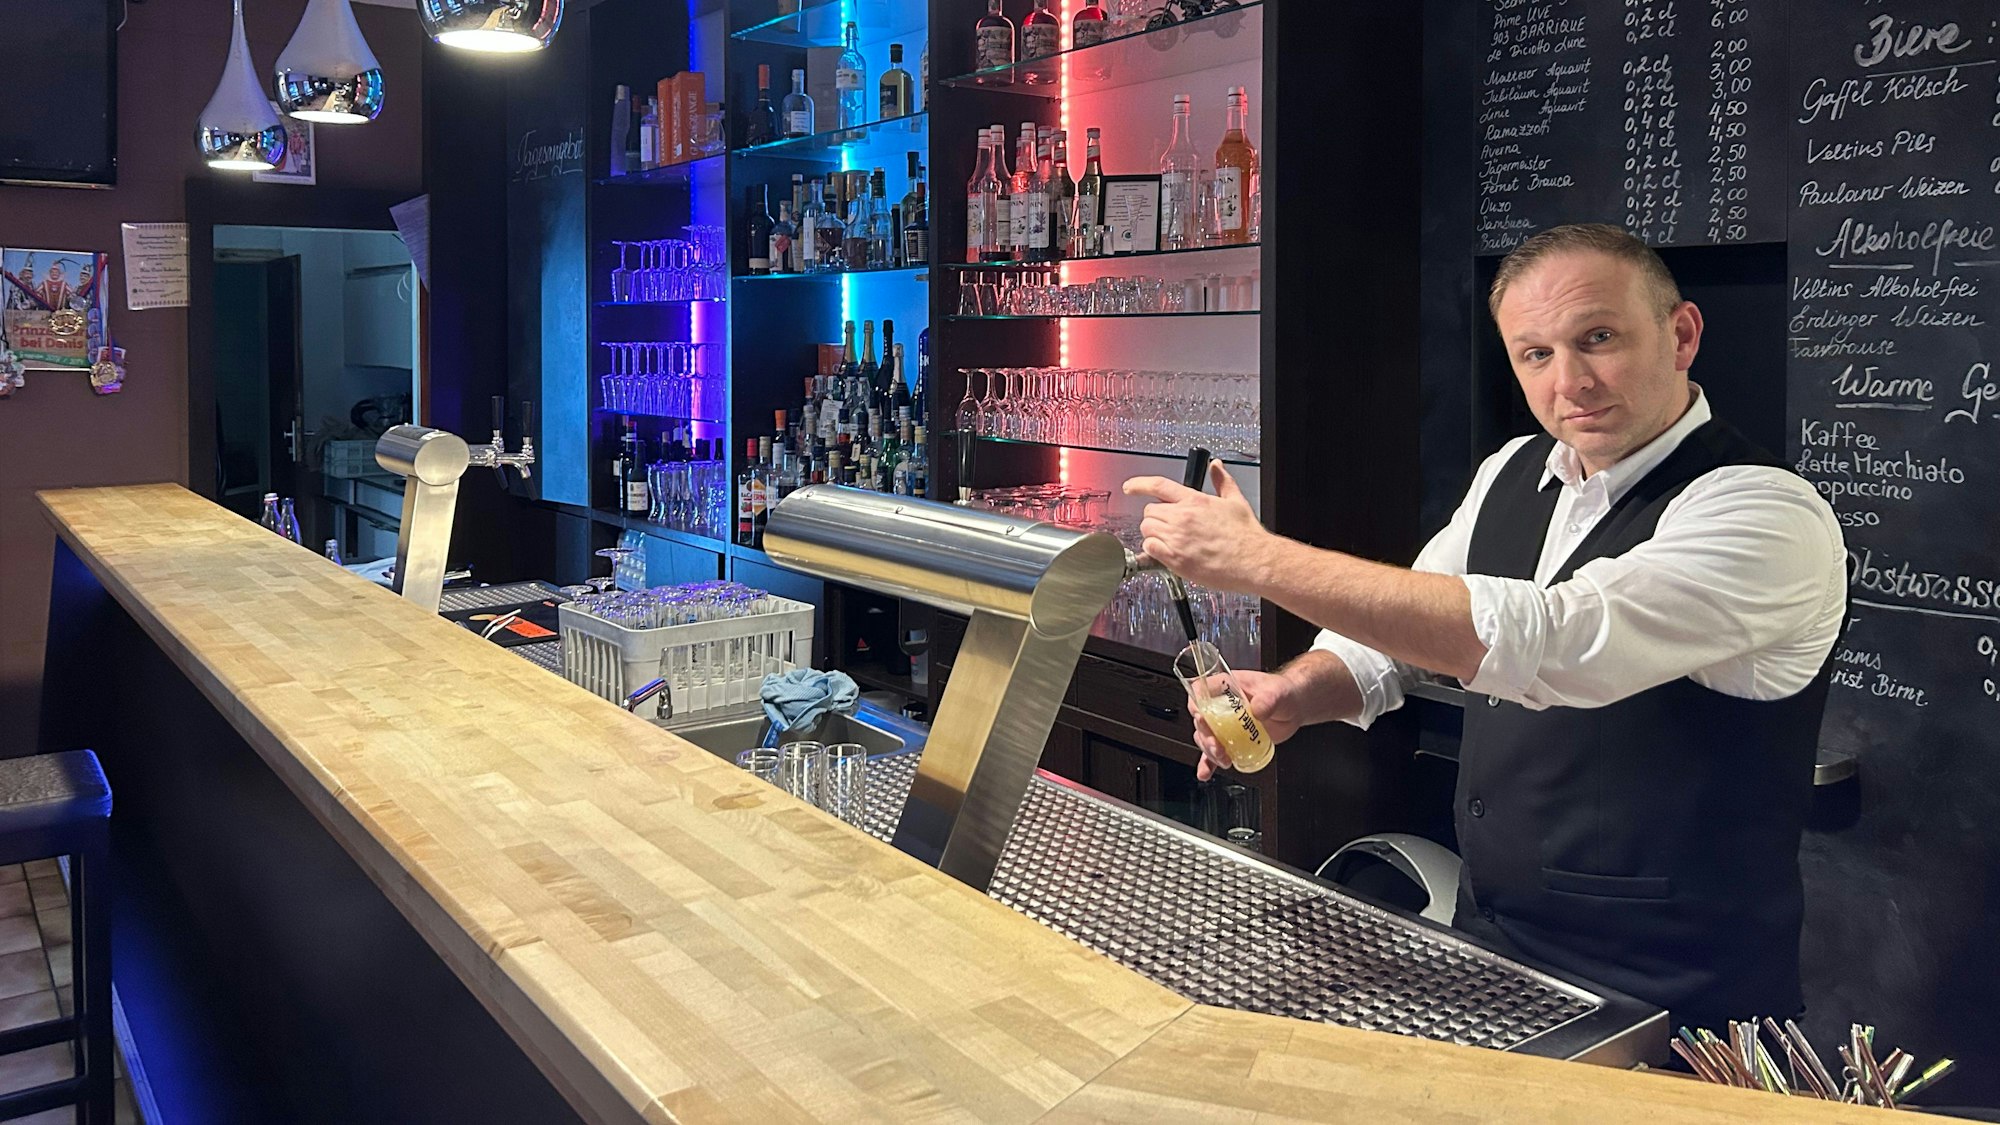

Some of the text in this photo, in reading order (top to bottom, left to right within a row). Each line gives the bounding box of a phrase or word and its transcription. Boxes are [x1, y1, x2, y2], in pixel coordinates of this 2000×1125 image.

[1491, 30, 1509, 46] 903
[1711, 8, 1749, 29] 6,00
[1527, 5, 1552, 23] UVE
[1483, 68, 1538, 86] Malteser
[1545, 58, 1591, 83] Aquavit
[1710, 38, 1748, 60] 2,00
[1482, 84, 1540, 106] Jubiläum
[1543, 78, 1591, 105] Aquavit
[1709, 57, 1752, 80] 3,00
[1798, 78, 1874, 124] Gaffel
[1881, 67, 1969, 104] Kölsch
[1538, 98, 1587, 122] Aquavit
[1712, 77, 1752, 100] 3,00
[1708, 101, 1748, 124] 4,50
[1480, 143, 1521, 160] Averna
[1708, 122, 1747, 144] 4,50
[1807, 130, 1936, 164] Veltins Pils
[1479, 155, 1552, 185] Jägermeister
[1708, 144, 1747, 167] 2,50
[1481, 177, 1519, 196] Fernet
[1710, 165, 1747, 186] 2,50
[1480, 197, 1512, 215] Ouzo
[1709, 187, 1748, 206] 2,00
[1799, 176, 1971, 207] Paulaner Weizen
[1477, 214, 1537, 232] Sambuca
[1708, 206, 1748, 227] 2,50
[1707, 225, 1747, 244] 4,50
[1793, 276, 1853, 301] Veltins
[1788, 305, 1985, 342] Erdinger Weizen
[20, 337, 84, 349] bei Denis
[1831, 363, 1934, 401] Warme
[1801, 418, 1880, 451] Kaffee
[1795, 448, 1965, 484] Latte Macchiato
[1239, 709, 1260, 741] Gaffel
